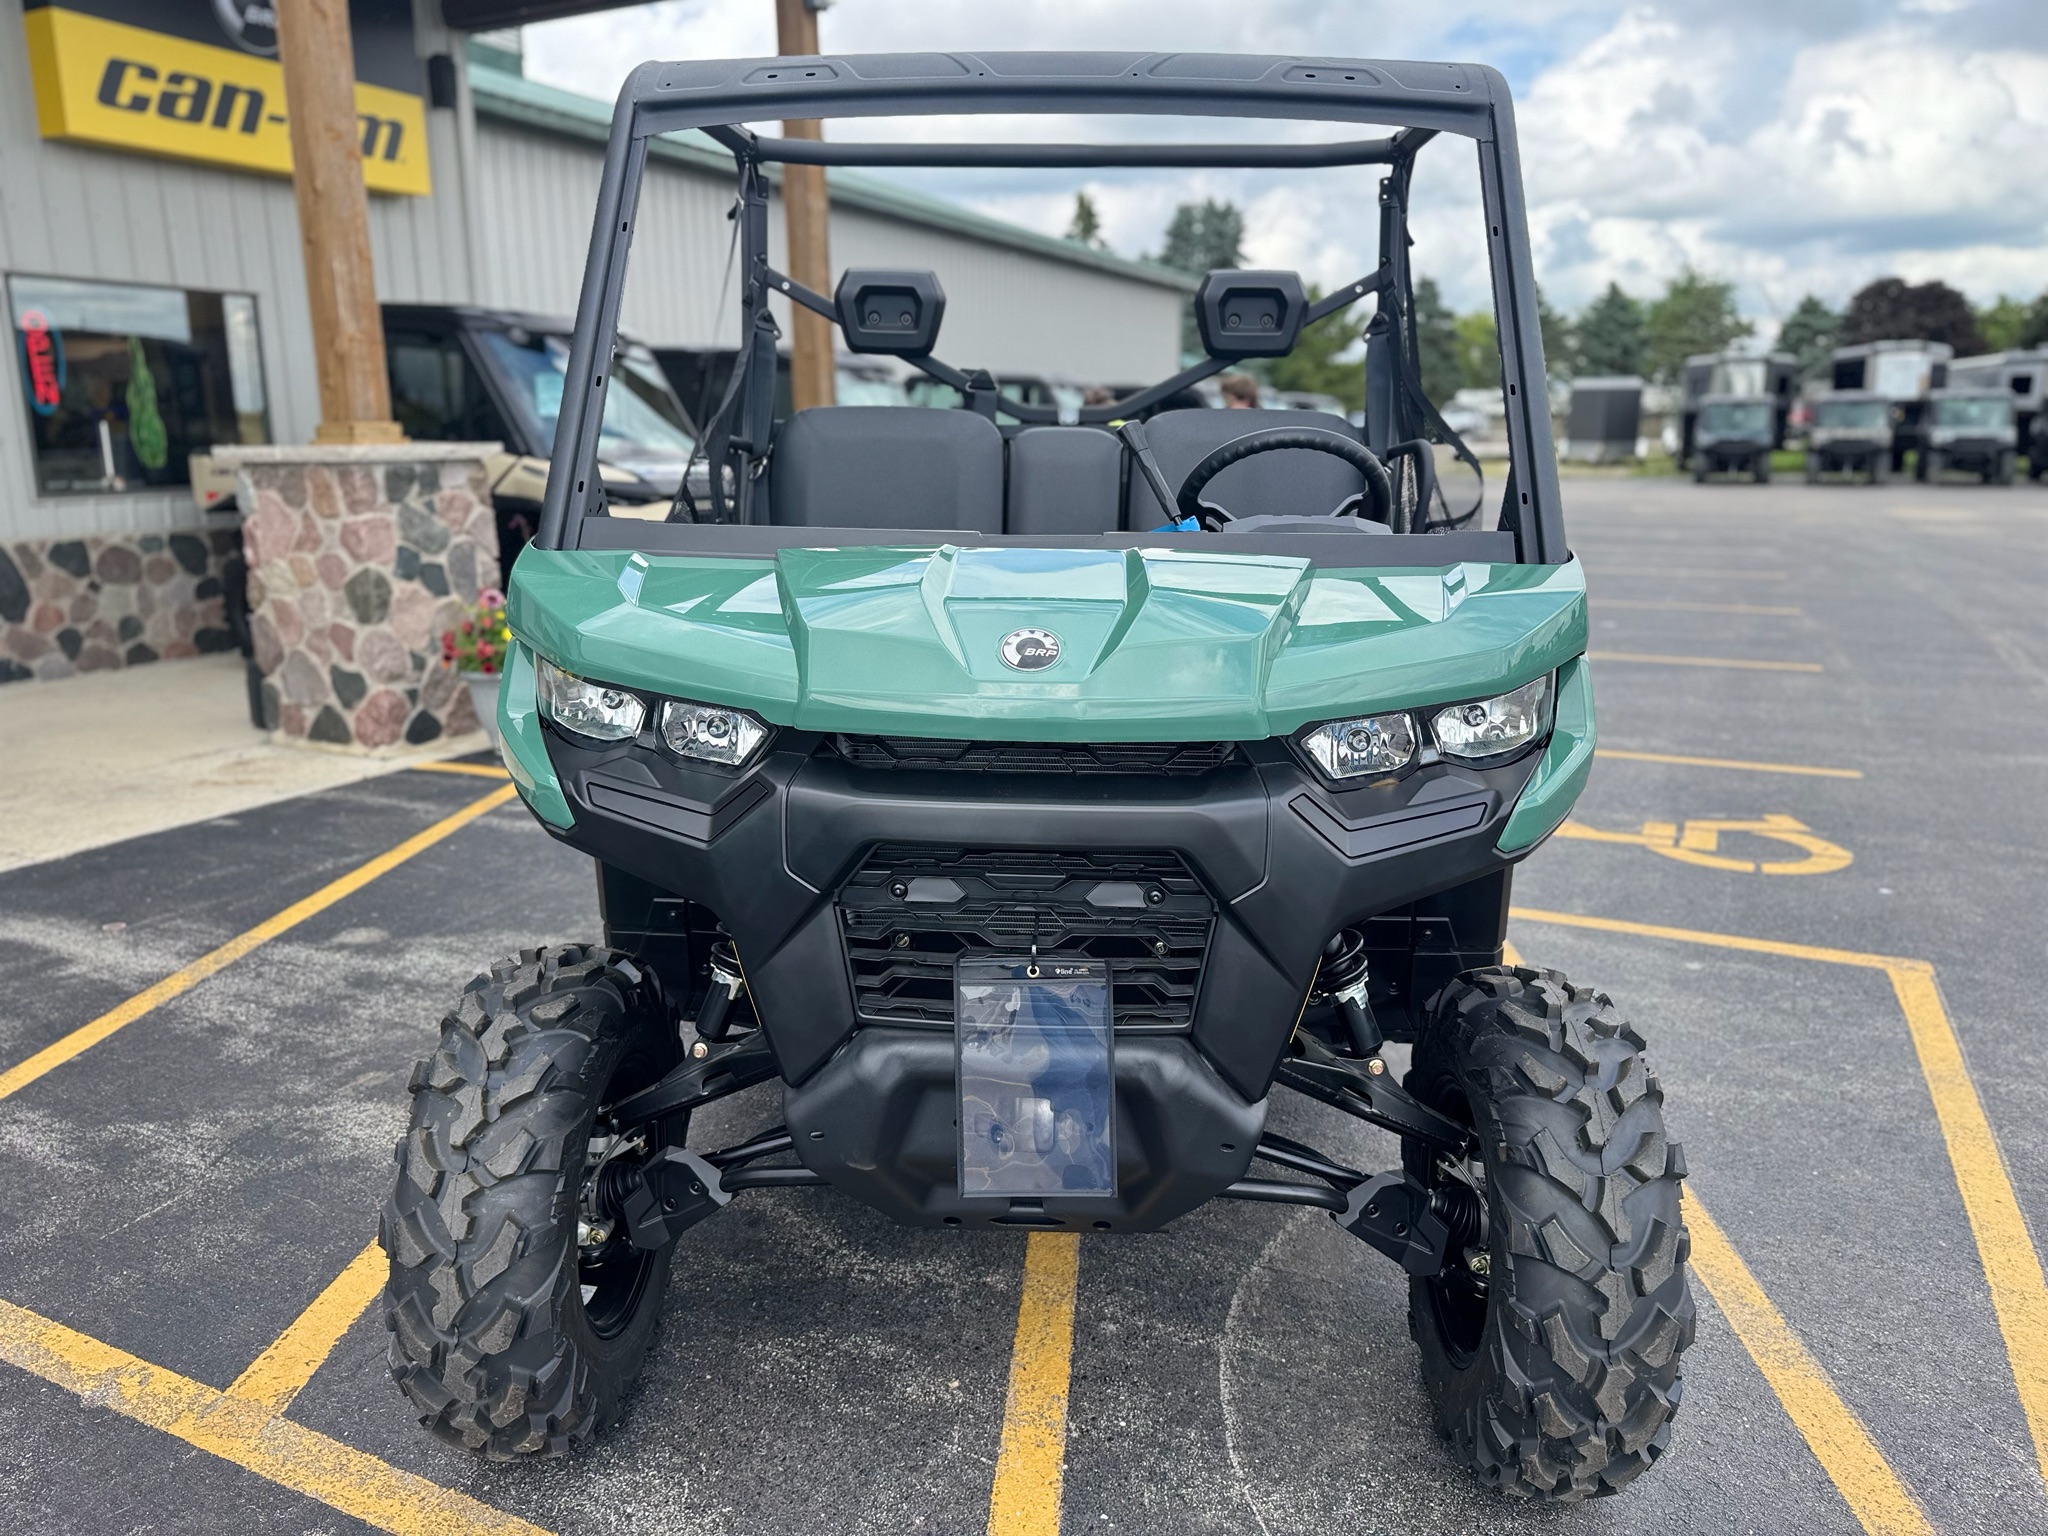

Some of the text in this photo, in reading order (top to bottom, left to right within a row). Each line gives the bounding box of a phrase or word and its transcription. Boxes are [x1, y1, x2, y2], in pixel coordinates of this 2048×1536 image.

[244, 4, 277, 28] BR
[97, 57, 404, 162] can-m
[21, 309, 60, 405] OPEN
[1024, 647, 1058, 657] BRP
